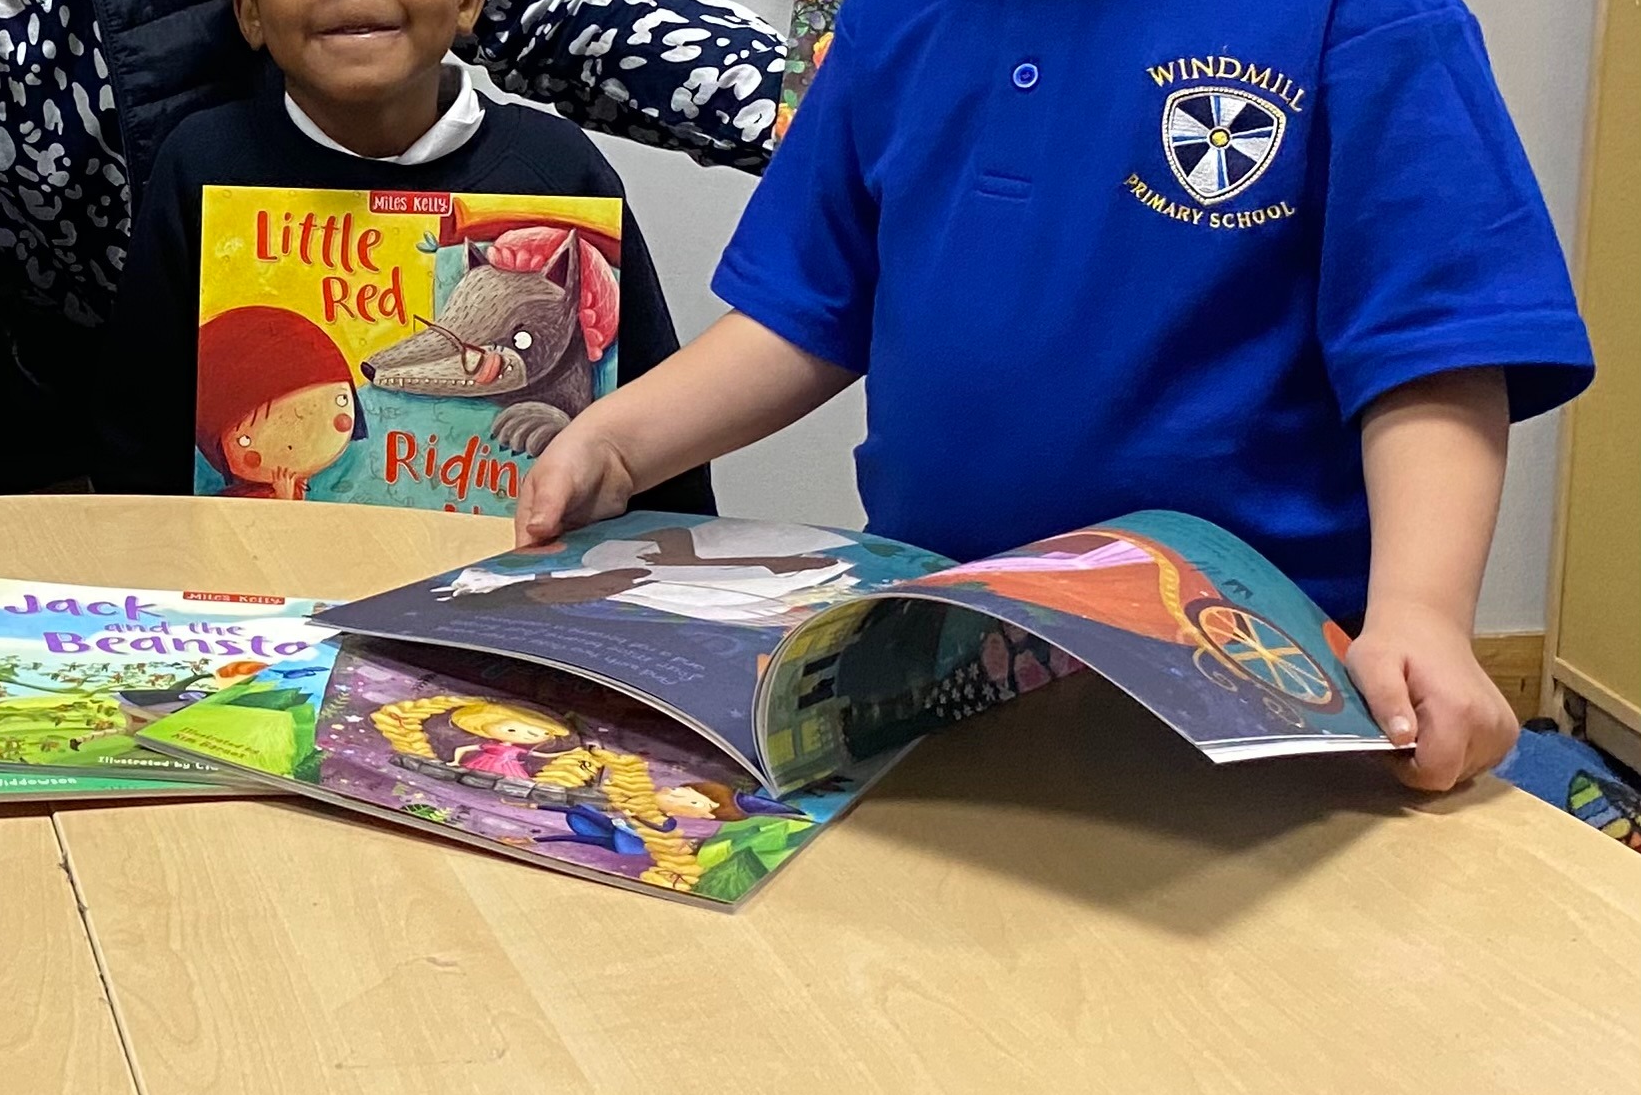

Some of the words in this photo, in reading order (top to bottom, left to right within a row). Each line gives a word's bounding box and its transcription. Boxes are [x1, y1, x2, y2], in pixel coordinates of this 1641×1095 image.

[1146, 55, 1306, 112] WINDMILL
[1123, 173, 1204, 225] PRIMARY
[1209, 200, 1296, 229] SCHOOL
[256, 210, 382, 273] Little
[321, 266, 408, 326] Red
[383, 430, 521, 501] Ridin
[5, 594, 163, 621] Jack
[104, 621, 169, 635] and
[189, 621, 247, 637] the
[98, 756, 170, 767] Illustrated
[174, 761, 190, 769] by
